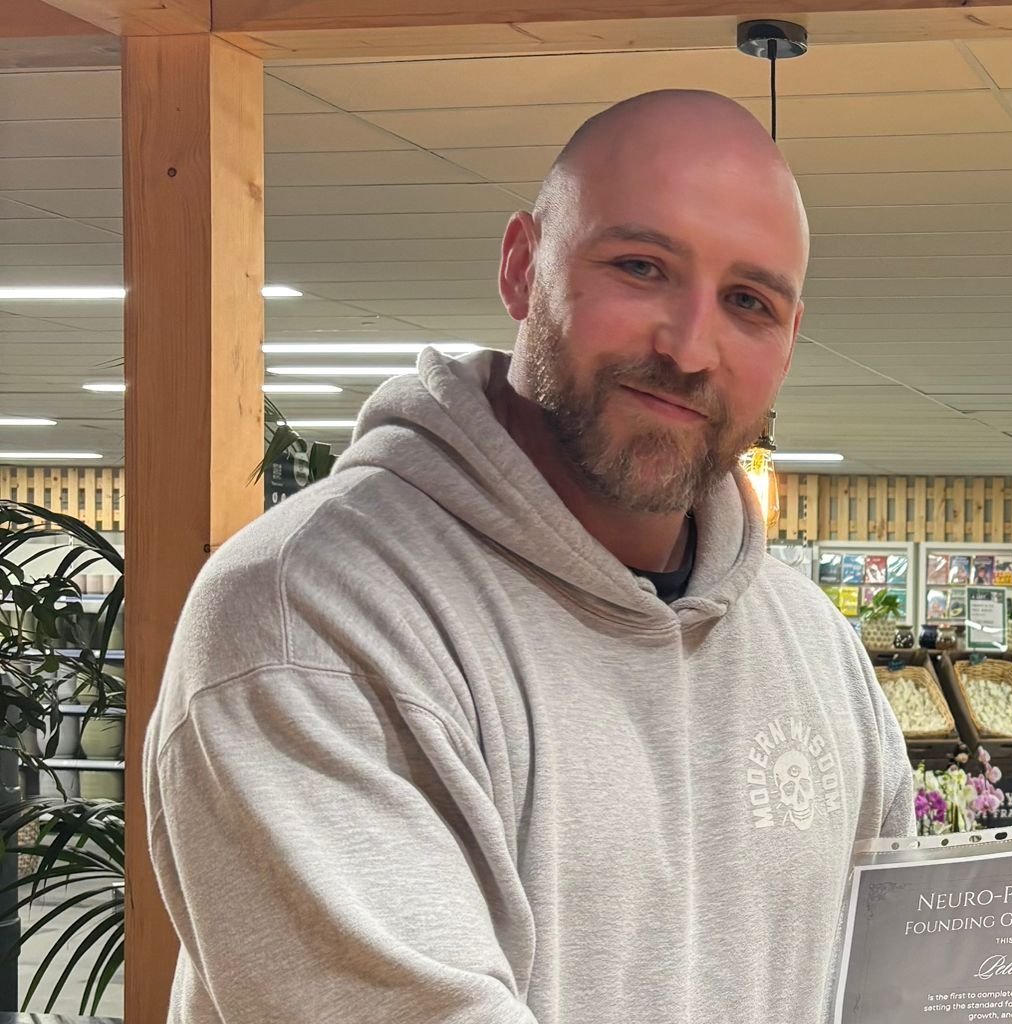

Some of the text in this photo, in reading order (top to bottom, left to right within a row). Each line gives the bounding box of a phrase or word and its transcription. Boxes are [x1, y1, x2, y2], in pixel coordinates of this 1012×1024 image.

[747, 716, 841, 829] MODERN WISDOM
[905, 915, 995, 935] FOUNDING
[936, 993, 948, 1001] the
[950, 992, 966, 1000] first
[967, 991, 976, 999] to
[924, 1003, 951, 1012] setting
[952, 1002, 966, 1010] the
[967, 1000, 1003, 1009] standard
[968, 1012, 999, 1021] growth,
